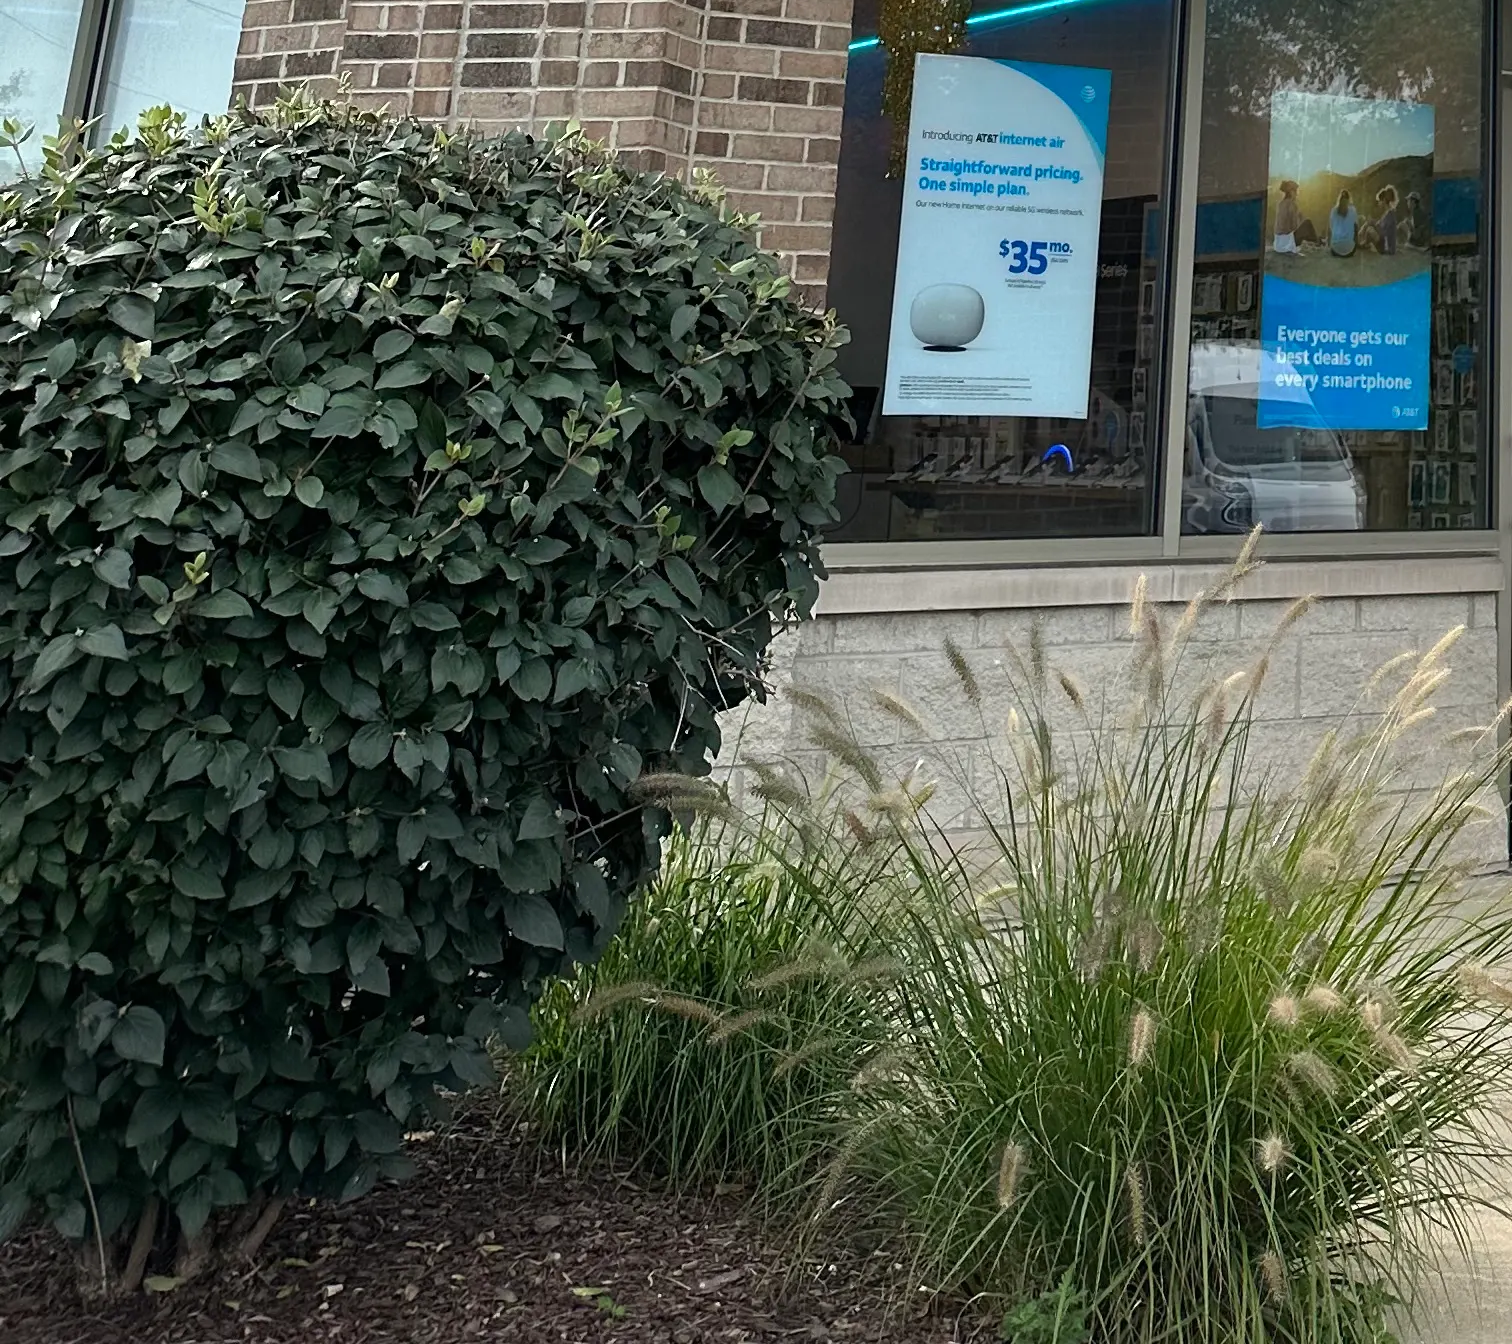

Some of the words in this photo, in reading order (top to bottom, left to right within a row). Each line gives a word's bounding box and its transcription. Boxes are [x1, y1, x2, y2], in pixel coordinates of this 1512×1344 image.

[922, 129, 973, 144] Introducing
[975, 132, 998, 143] AT&T
[999, 131, 1047, 148] internet
[1049, 136, 1066, 149] air
[920, 157, 1032, 178] Straightforward
[1034, 165, 1084, 184] pricing.
[919, 176, 947, 191] One
[949, 178, 995, 197] simple
[997, 181, 1030, 197] plan.
[916, 199, 927, 207] Our
[1049, 241, 1073, 254] mo.
[1277, 325, 1347, 347] Everyone
[1350, 329, 1382, 348] gets
[1385, 333, 1411, 346] our
[1275, 347, 1310, 365] best
[1313, 349, 1351, 365] deals
[1355, 354, 1373, 366] on
[1275, 373, 1318, 392] every
[1322, 372, 1412, 393] smartphone
